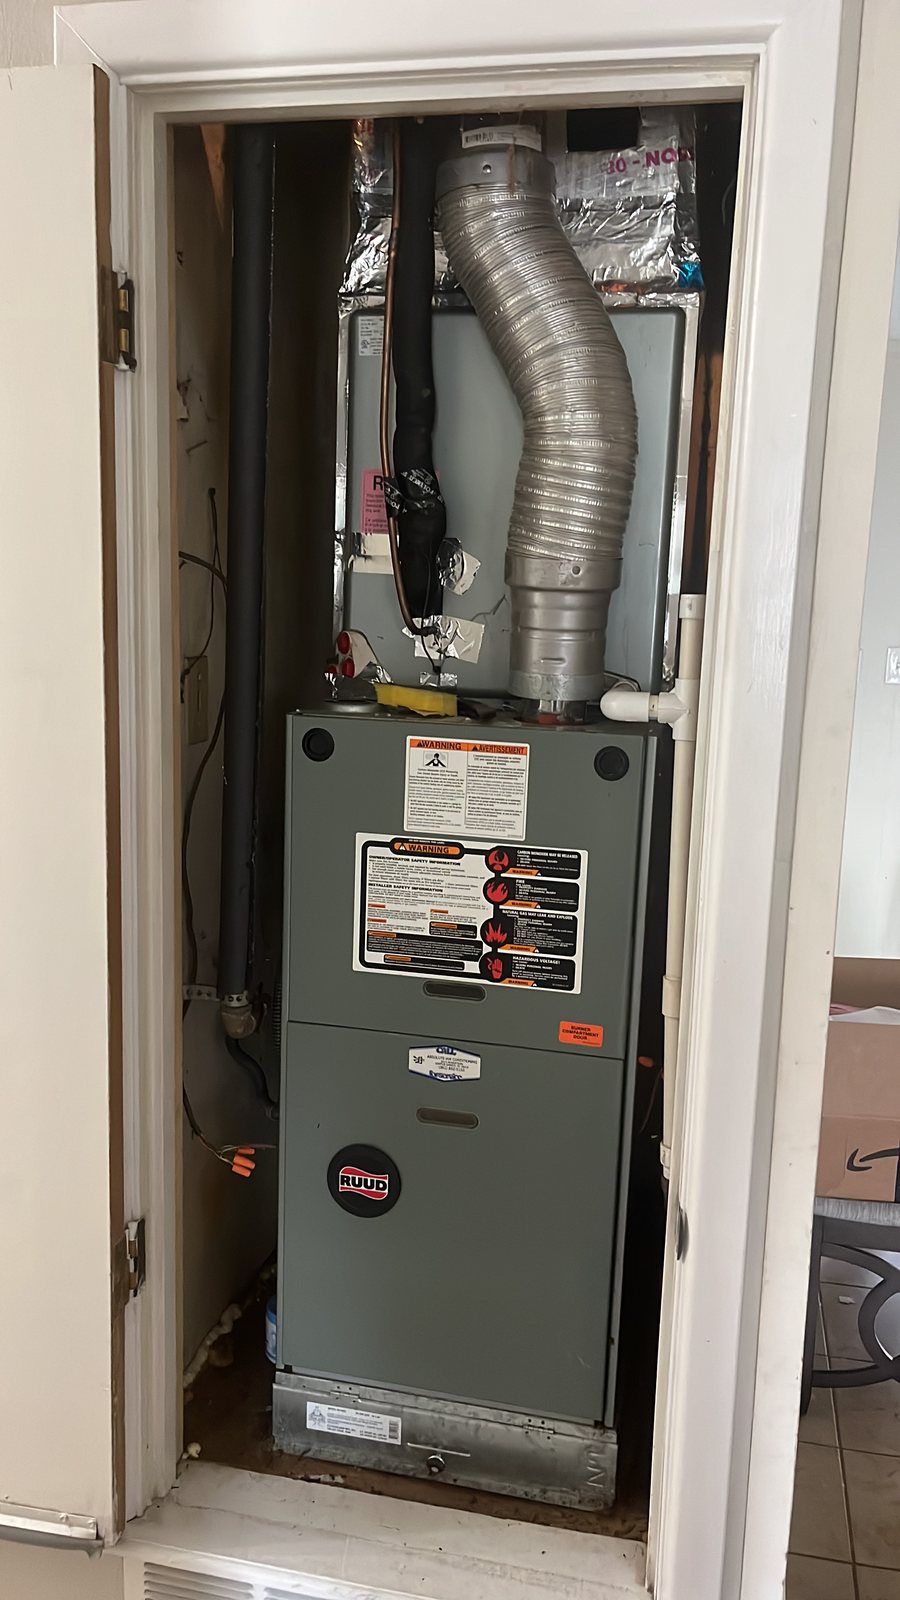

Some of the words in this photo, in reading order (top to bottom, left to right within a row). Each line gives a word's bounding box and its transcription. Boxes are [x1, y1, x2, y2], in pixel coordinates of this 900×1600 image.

[422, 740, 461, 750] WARNING
[479, 744, 524, 753] AVERTISSEMENT
[408, 844, 449, 854] WARNING
[512, 955, 539, 963] HAZARDOUS
[562, 1029, 599, 1038] COMPARTMENT
[340, 1174, 388, 1191] RUUD
